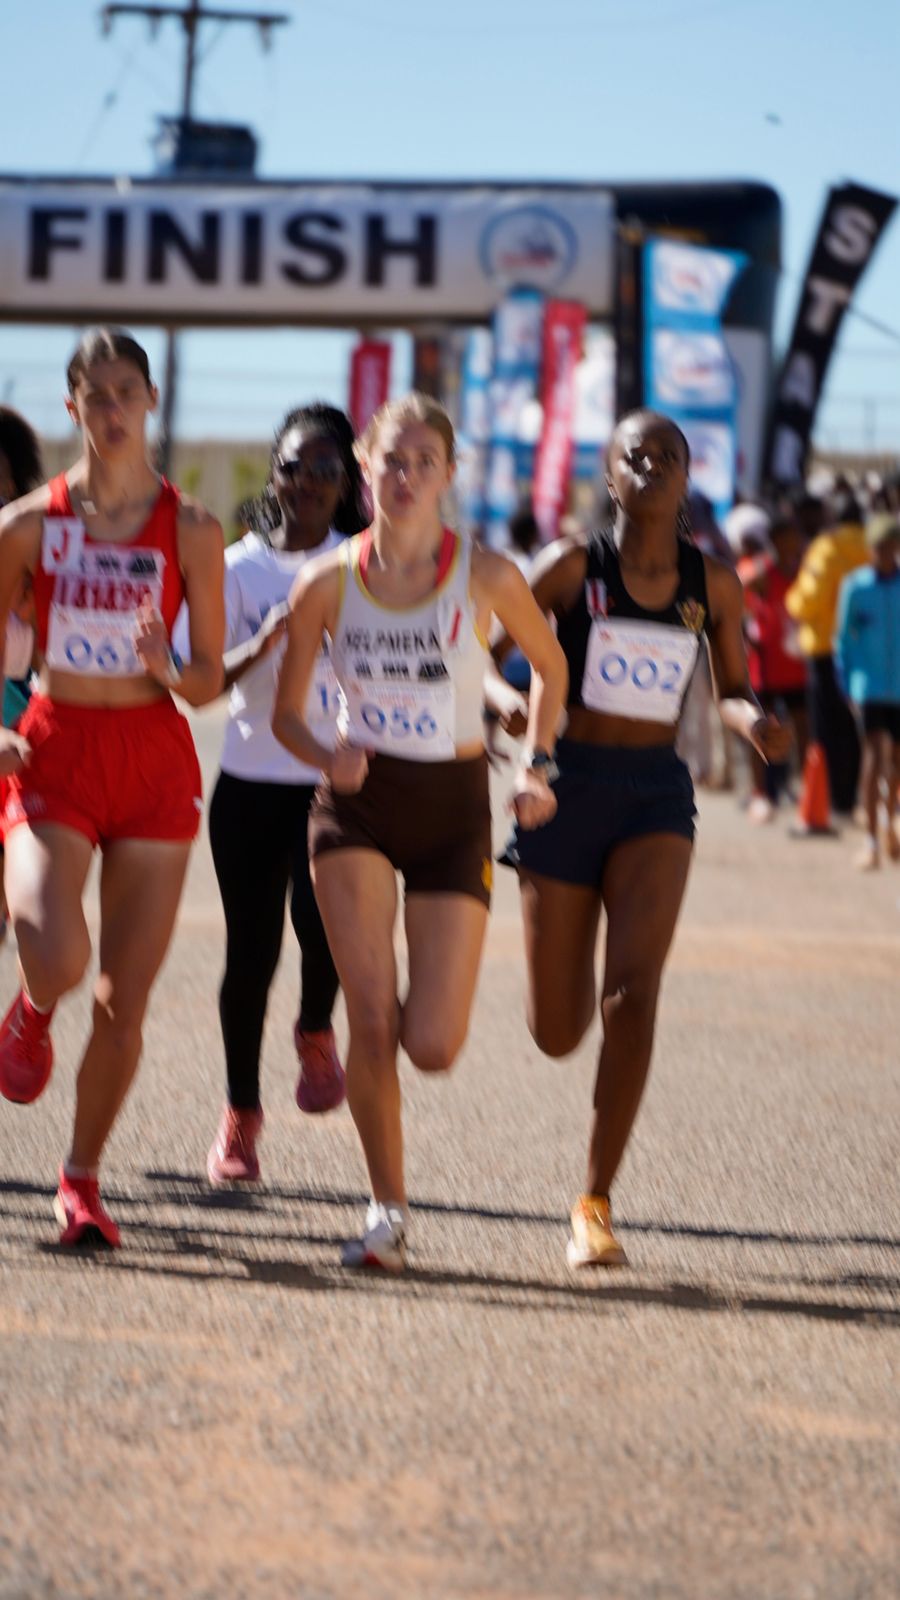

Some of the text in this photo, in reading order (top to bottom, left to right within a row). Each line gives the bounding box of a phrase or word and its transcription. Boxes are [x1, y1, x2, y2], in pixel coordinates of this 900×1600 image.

[27, 209, 438, 288] FINISH
[599, 652, 682, 694] 002
[360, 702, 438, 740] 056
